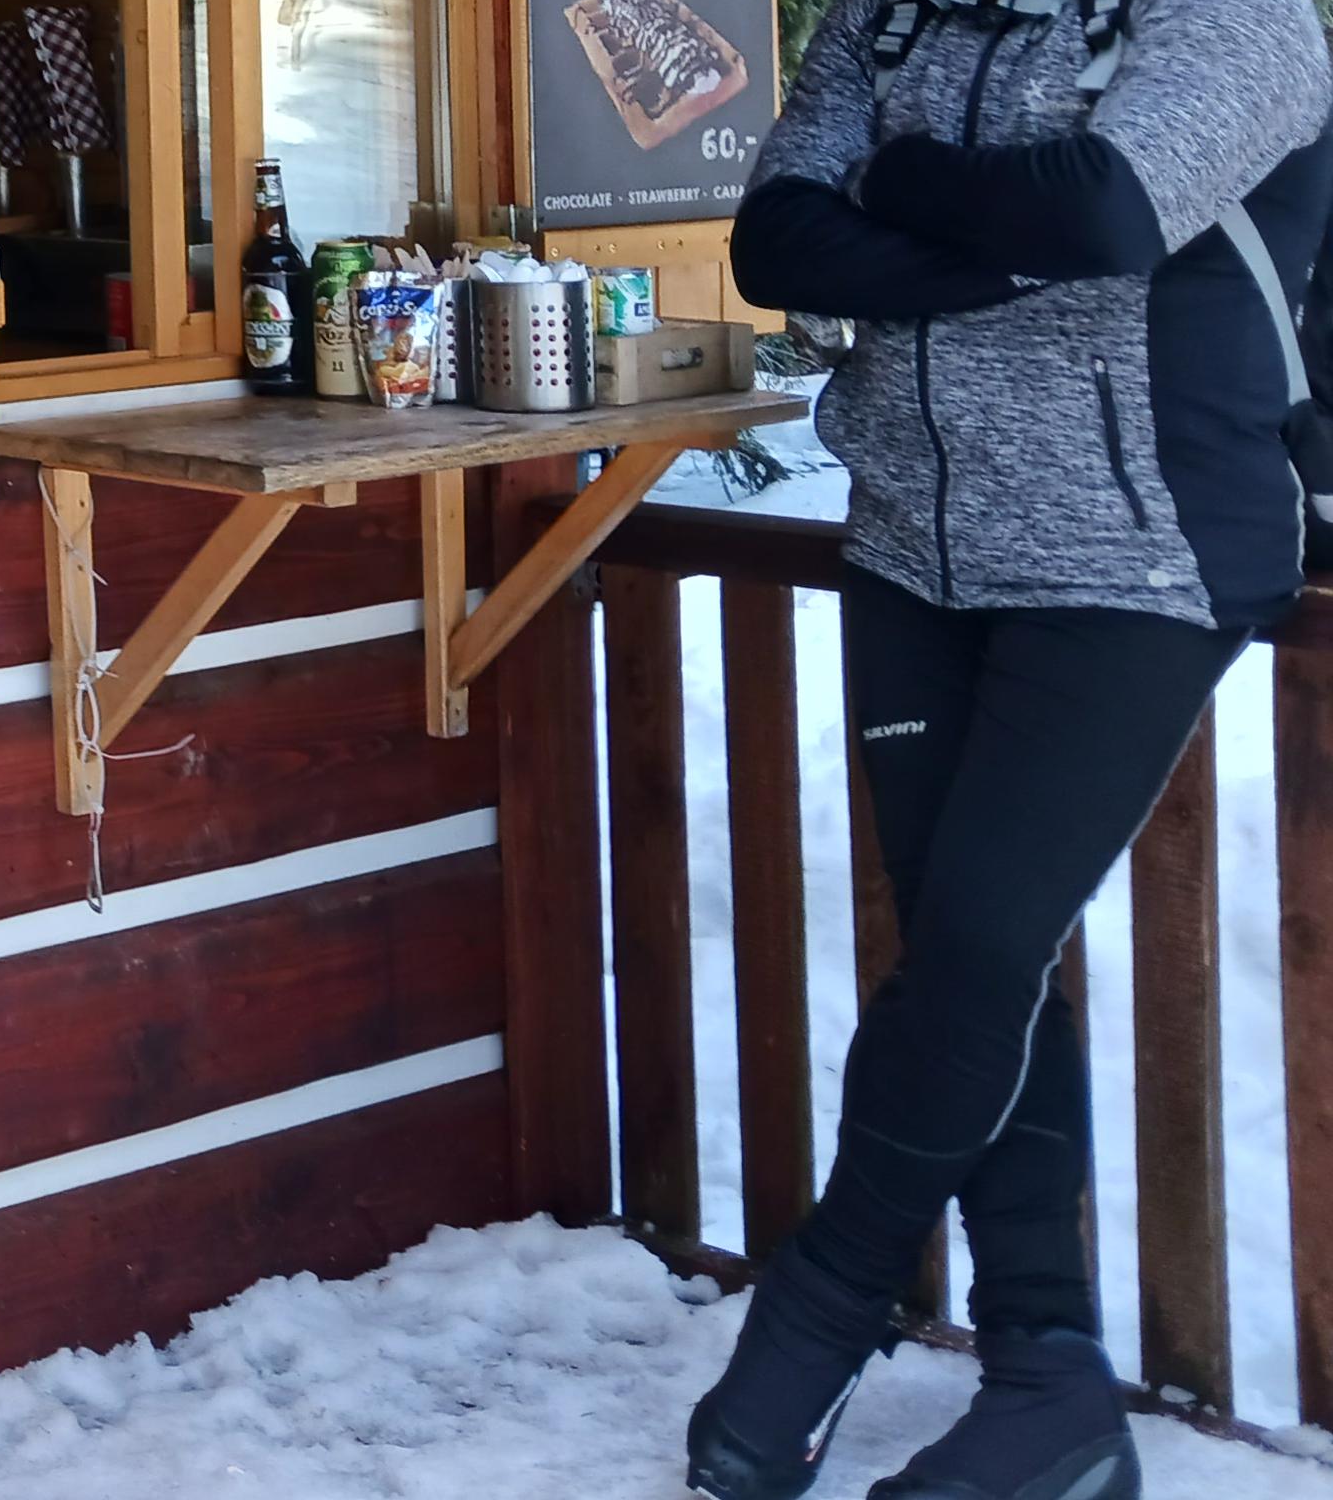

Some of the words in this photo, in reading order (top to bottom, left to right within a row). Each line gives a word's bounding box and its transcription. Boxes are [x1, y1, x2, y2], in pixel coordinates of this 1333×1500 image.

[701, 127, 758, 162] 60,-
[543, 191, 614, 211] CHOCOLATE
[627, 186, 701, 206] STRAWBERRY
[713, 184, 745, 200] CARA
